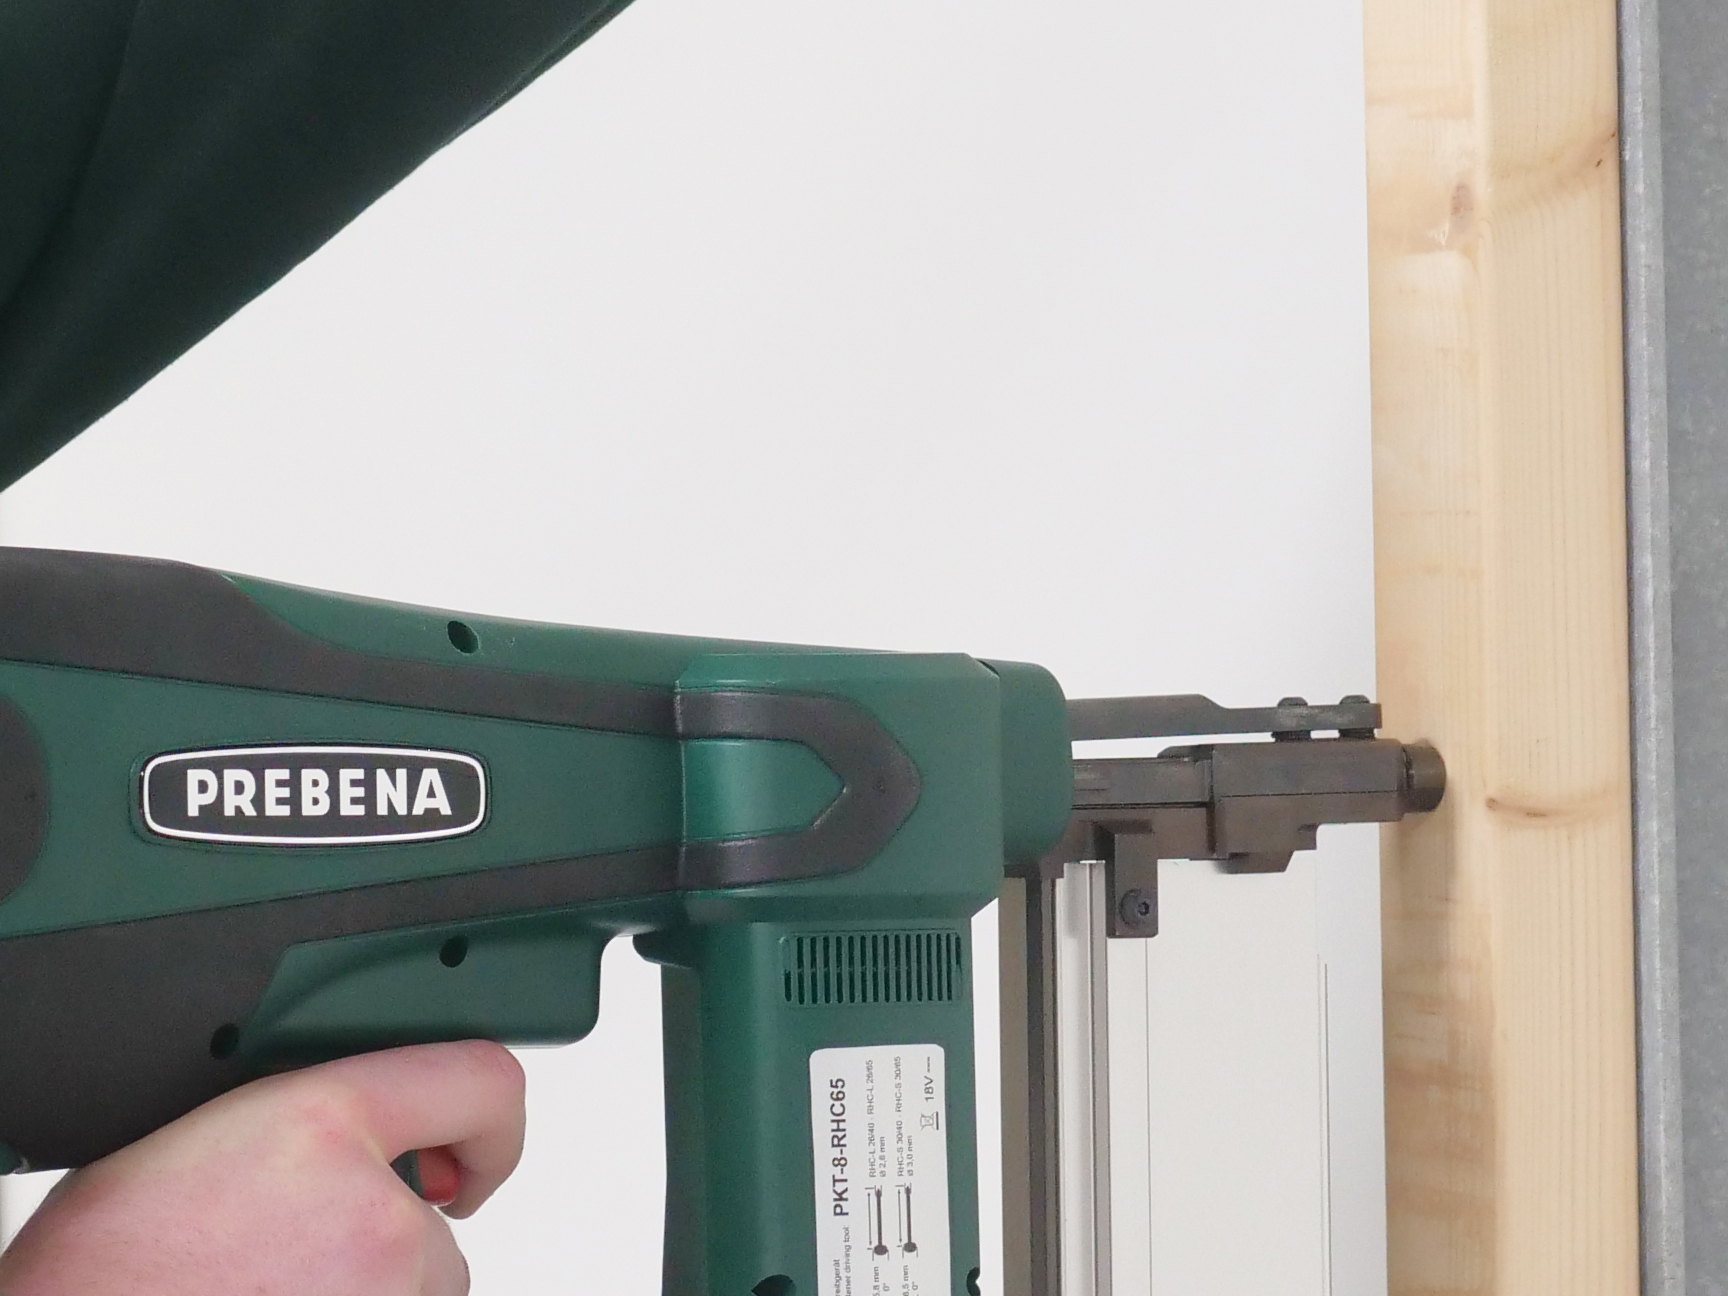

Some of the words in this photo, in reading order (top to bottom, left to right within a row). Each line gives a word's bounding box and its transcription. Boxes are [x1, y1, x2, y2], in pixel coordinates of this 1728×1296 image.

[186, 767, 452, 817] PREBENA
[866, 1085, 874, 1115] RHC-L
[924, 1076, 934, 1102] 18V
[830, 1078, 849, 1216] PKT-8-RHC65
[880, 1137, 885, 1152] mm
[907, 1135, 913, 1151] mm
[868, 1148, 876, 1178] RHC-L
[843, 1245, 851, 1273] driving
[874, 1266, 879, 1282] mm
[903, 1265, 908, 1281] mm
